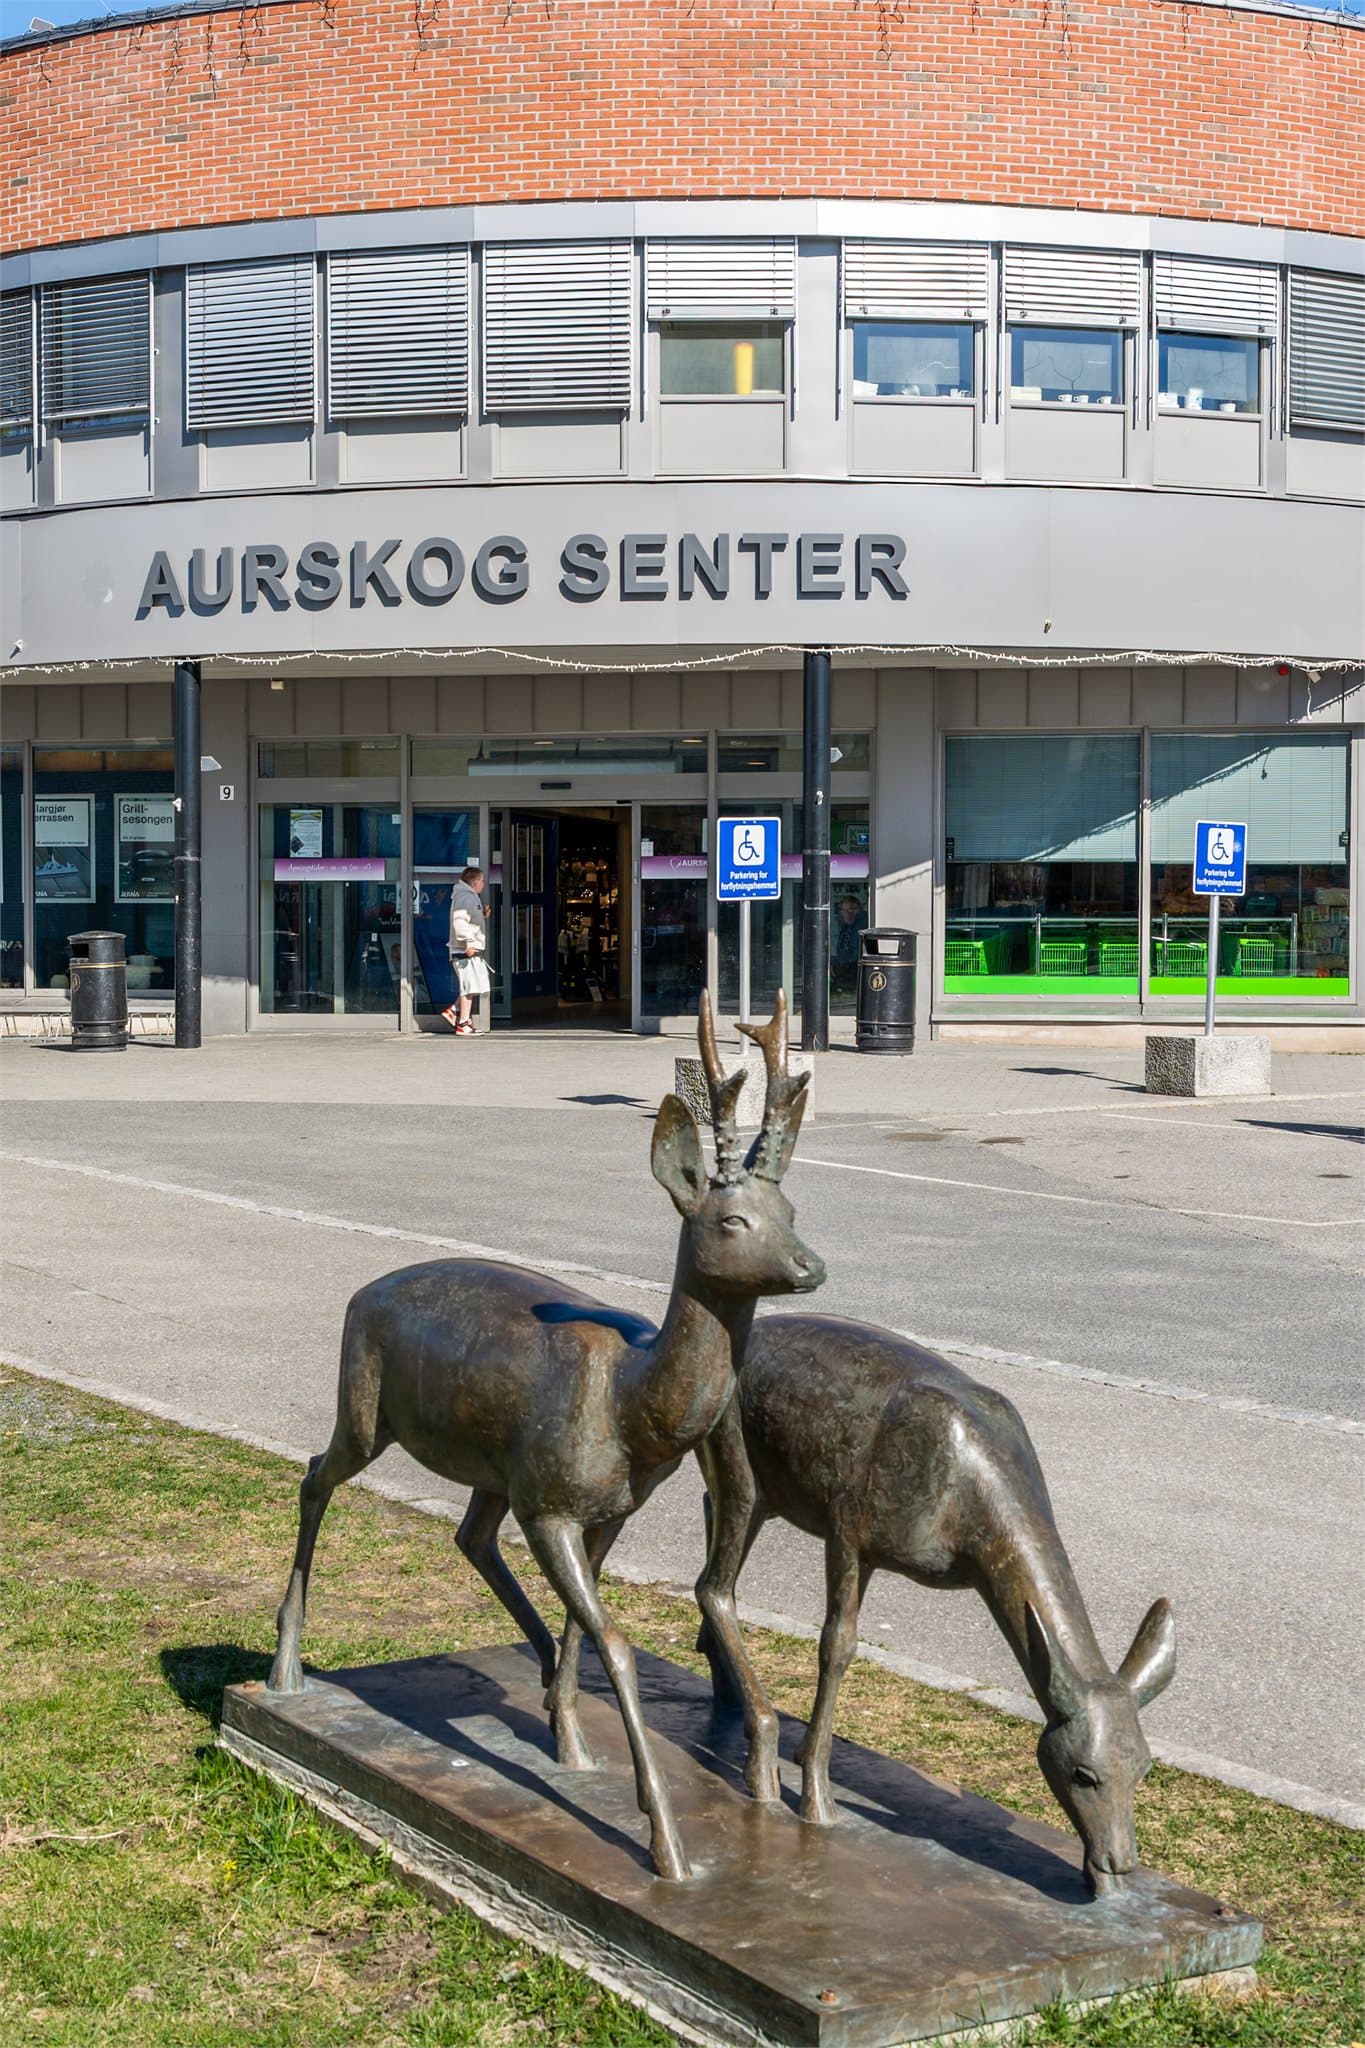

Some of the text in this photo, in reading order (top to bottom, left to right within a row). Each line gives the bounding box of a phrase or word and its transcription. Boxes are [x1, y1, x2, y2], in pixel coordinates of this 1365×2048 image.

[138, 533, 911, 614] AURSKOG SENTER
[223, 786, 231, 799] 9
[36, 803, 67, 815] largjør
[122, 804, 149, 814] Grill-
[35, 815, 74, 823] errassen
[122, 815, 173, 826] sesongen
[730, 870, 768, 881] Parkering for
[1204, 869, 1227, 878] Parkering
